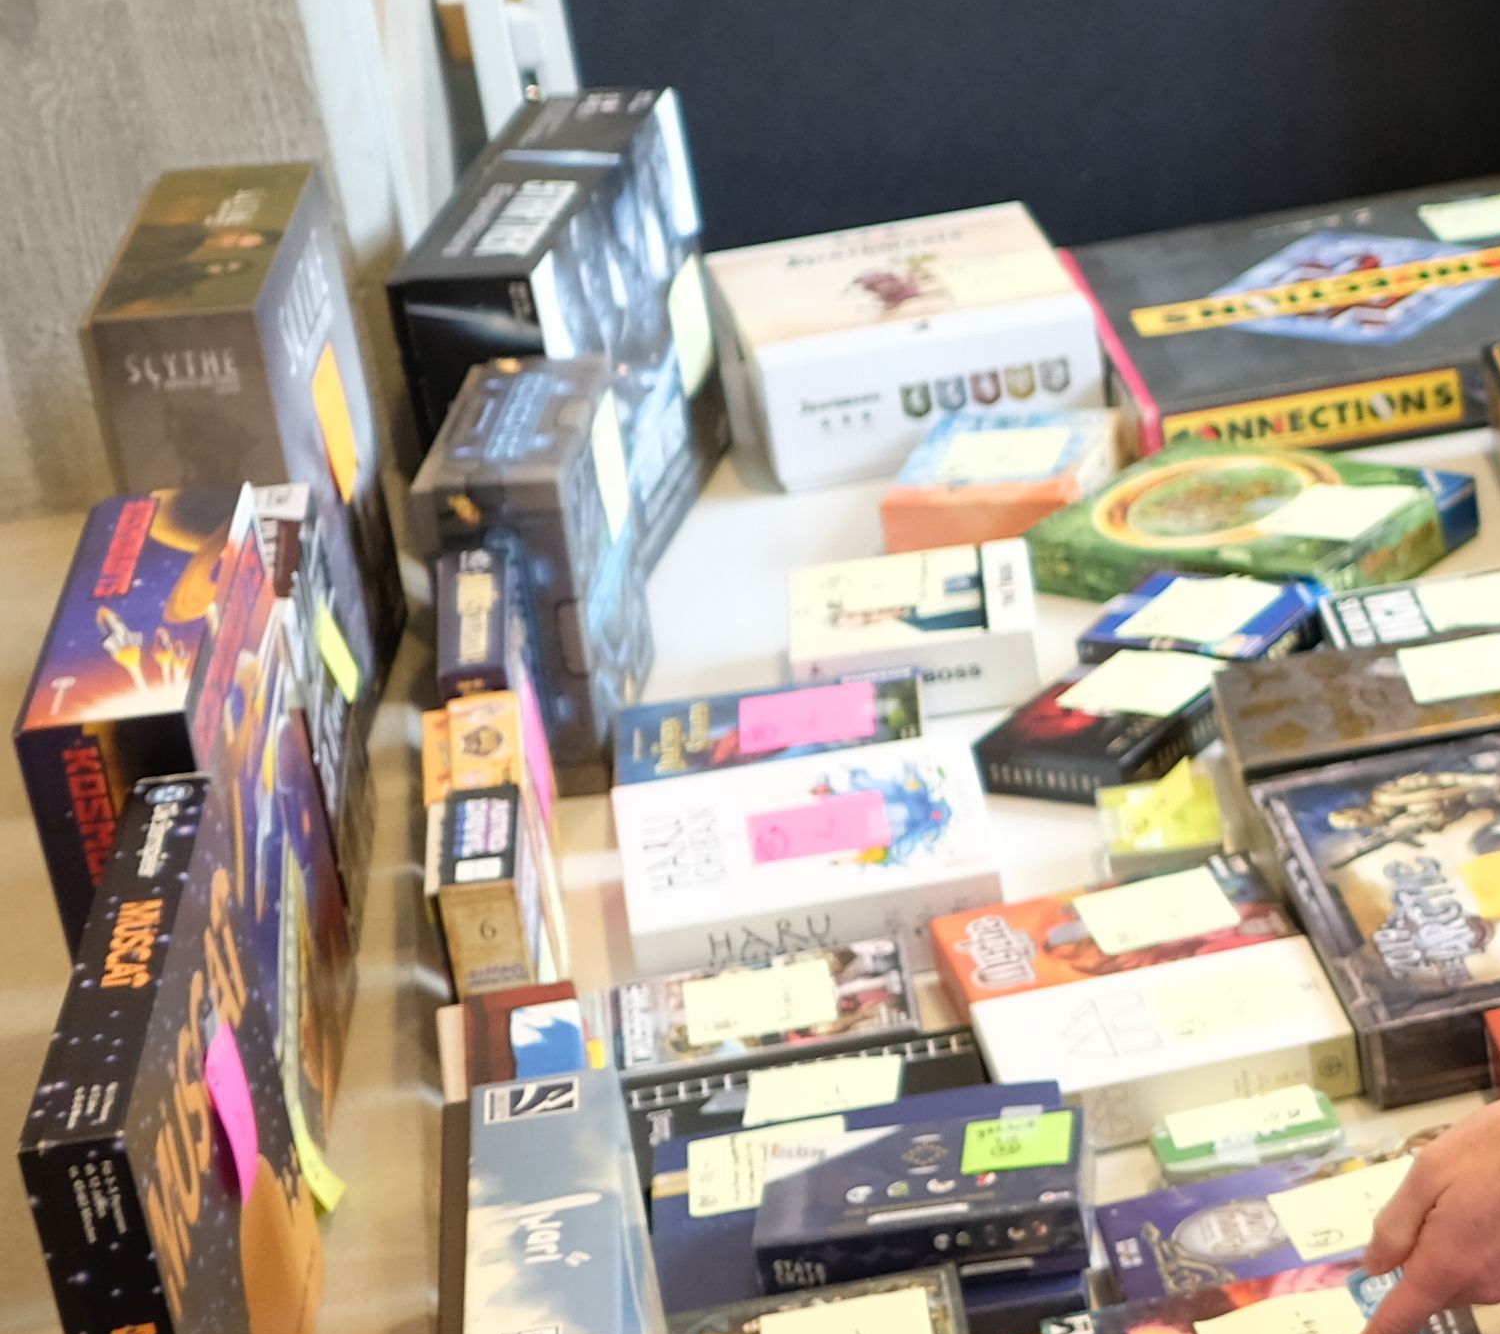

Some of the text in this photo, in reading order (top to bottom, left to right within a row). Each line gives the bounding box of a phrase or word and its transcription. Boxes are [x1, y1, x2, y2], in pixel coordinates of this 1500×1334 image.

[125, 348, 238, 384] SCYTHE
[101, 898, 165, 989] MUSCAT
[707, 914, 834, 955] HARU
[494, 1191, 604, 1266] Iwari
